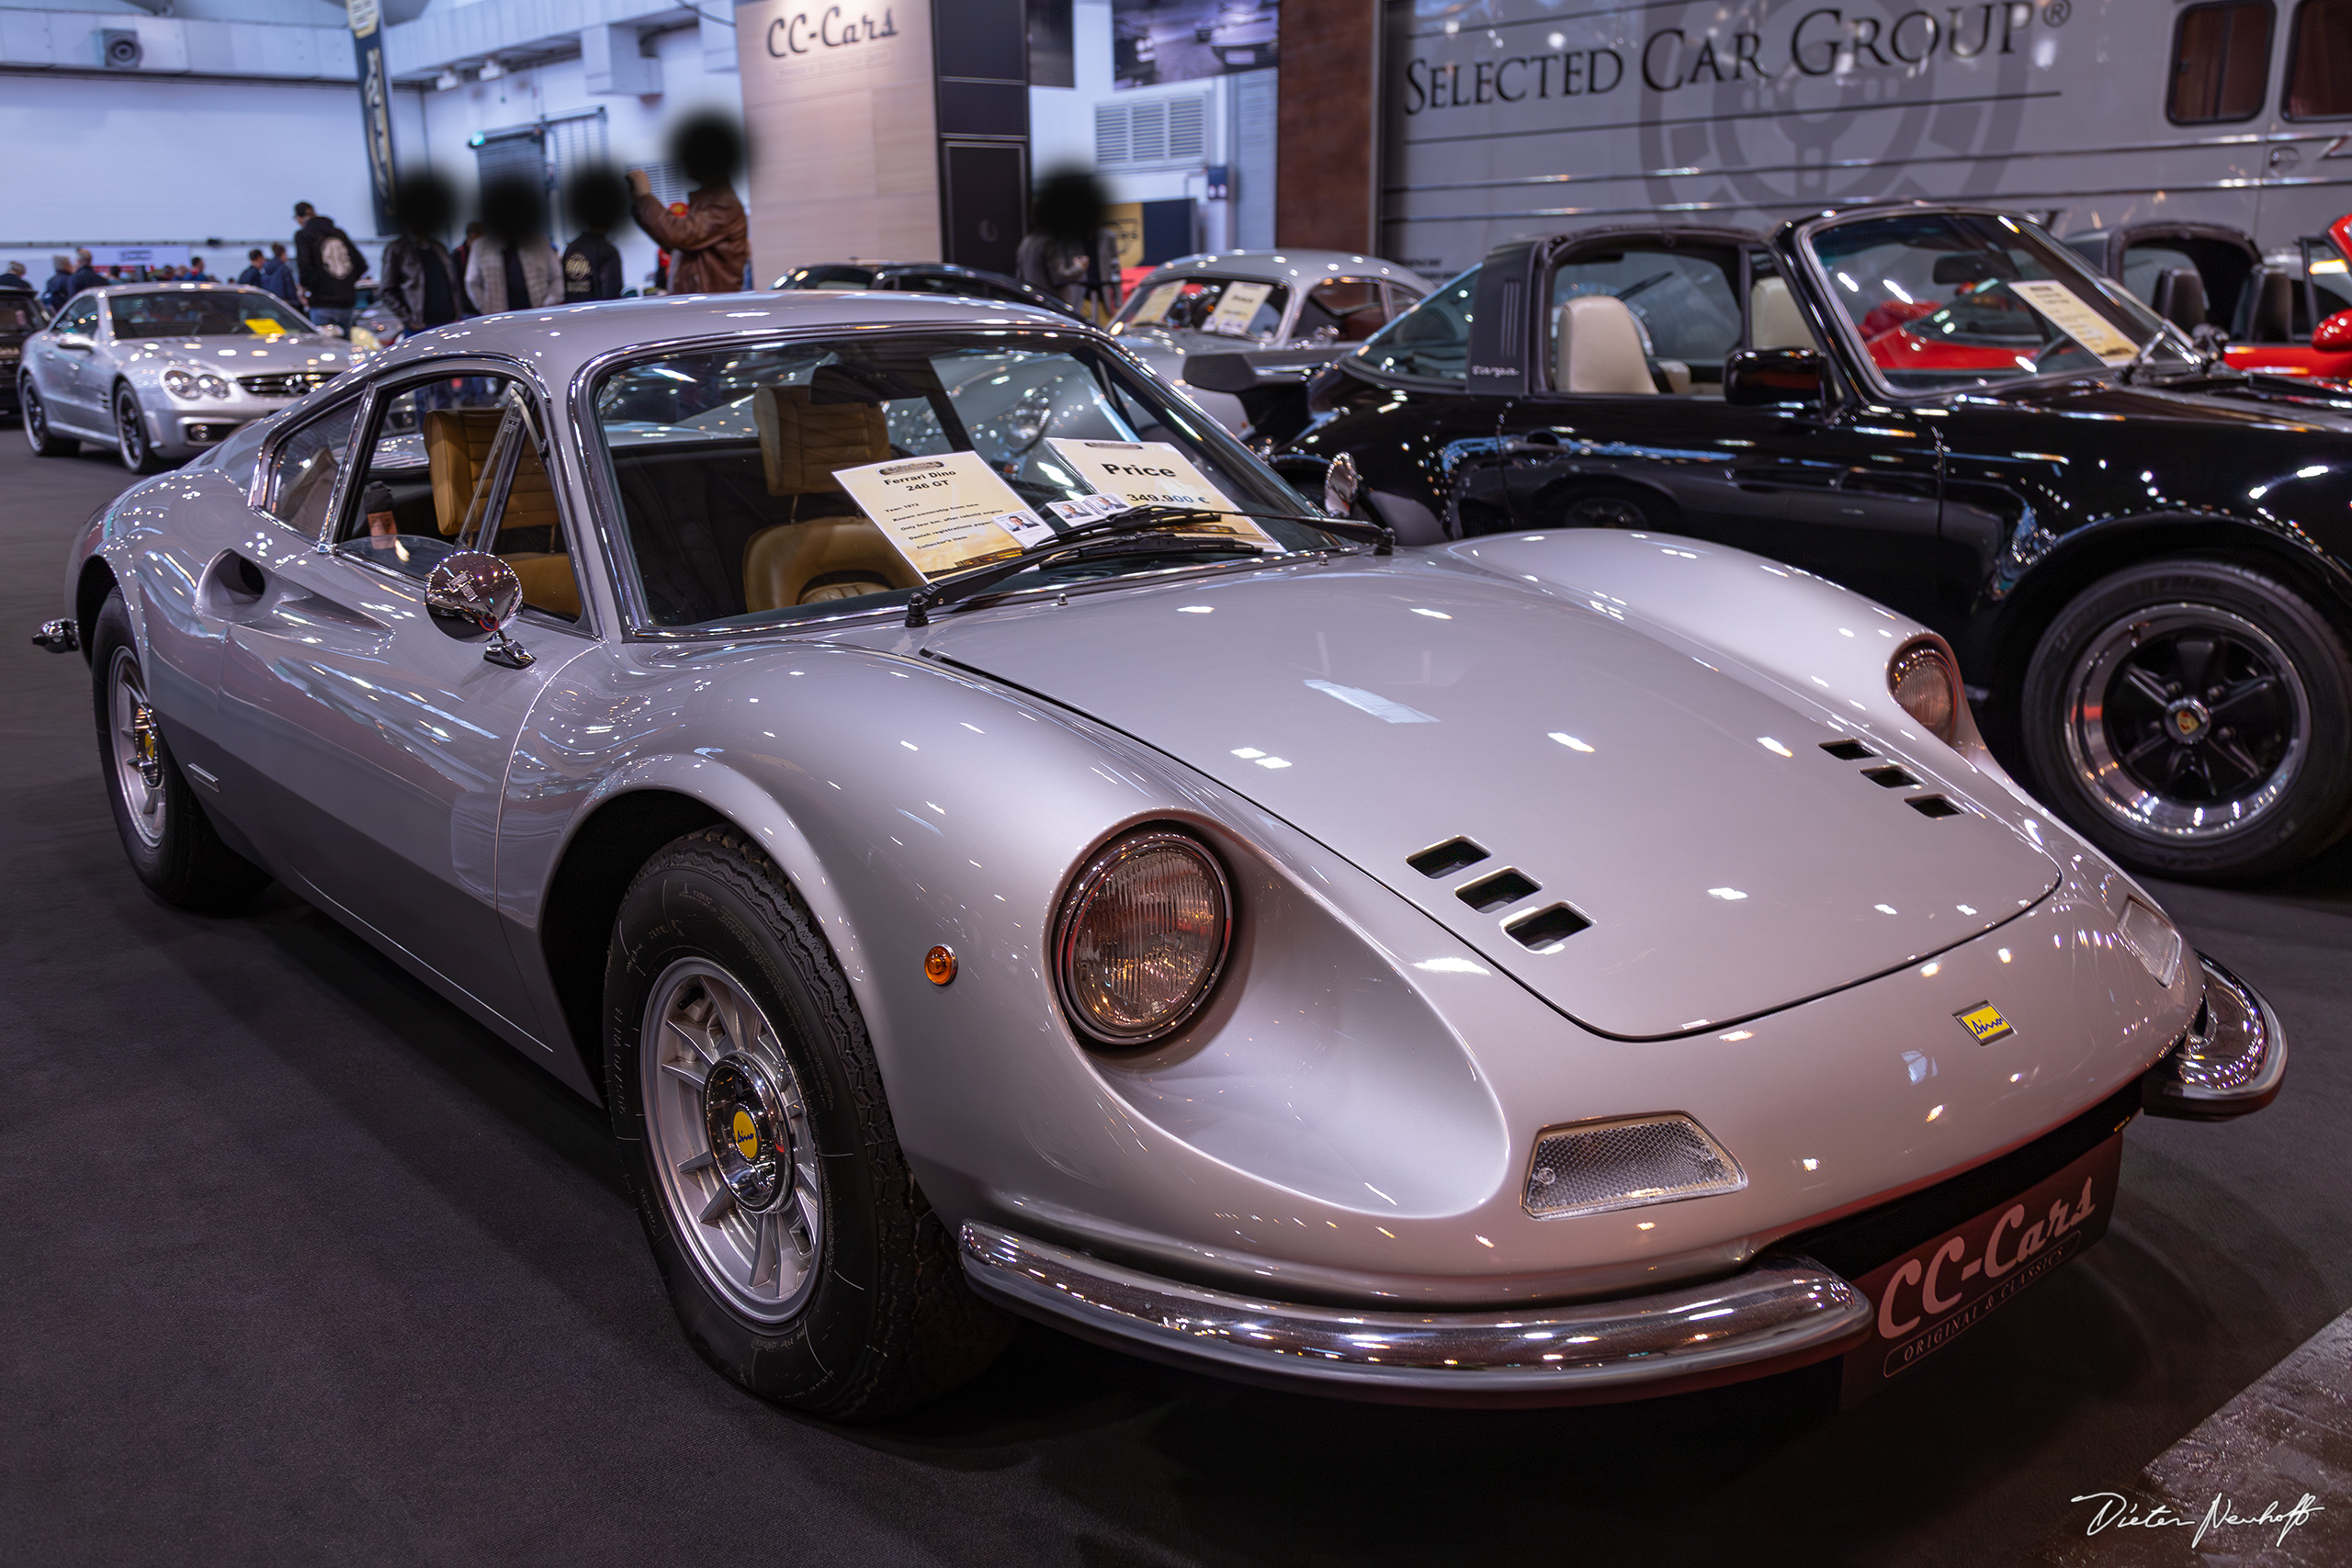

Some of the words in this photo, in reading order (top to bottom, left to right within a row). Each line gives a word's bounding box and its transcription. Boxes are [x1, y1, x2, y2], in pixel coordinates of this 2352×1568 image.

[766, 6, 899, 58] CC-Cars
[1404, 48, 1624, 117] SELECTED
[1641, 28, 1771, 93] CAR
[884, 473, 925, 486] Ferrari
[929, 469, 956, 479] Dino
[1101, 463, 1177, 478] Price
[906, 482, 930, 491] 246
[933, 479, 950, 488] GT
[1126, 493, 1194, 503] 349.900
[1198, 496, 1211, 504] €
[893, 514, 916, 523] Known
[917, 507, 949, 517] ownership
[960, 511, 981, 519] rebuild
[909, 532, 932, 541] Danish
[932, 524, 973, 536] registrations
[917, 538, 952, 550] Collector's
[1878, 1176, 2096, 1339] CC-Cars
[1904, 1305, 1977, 1362] ORIGINAL
